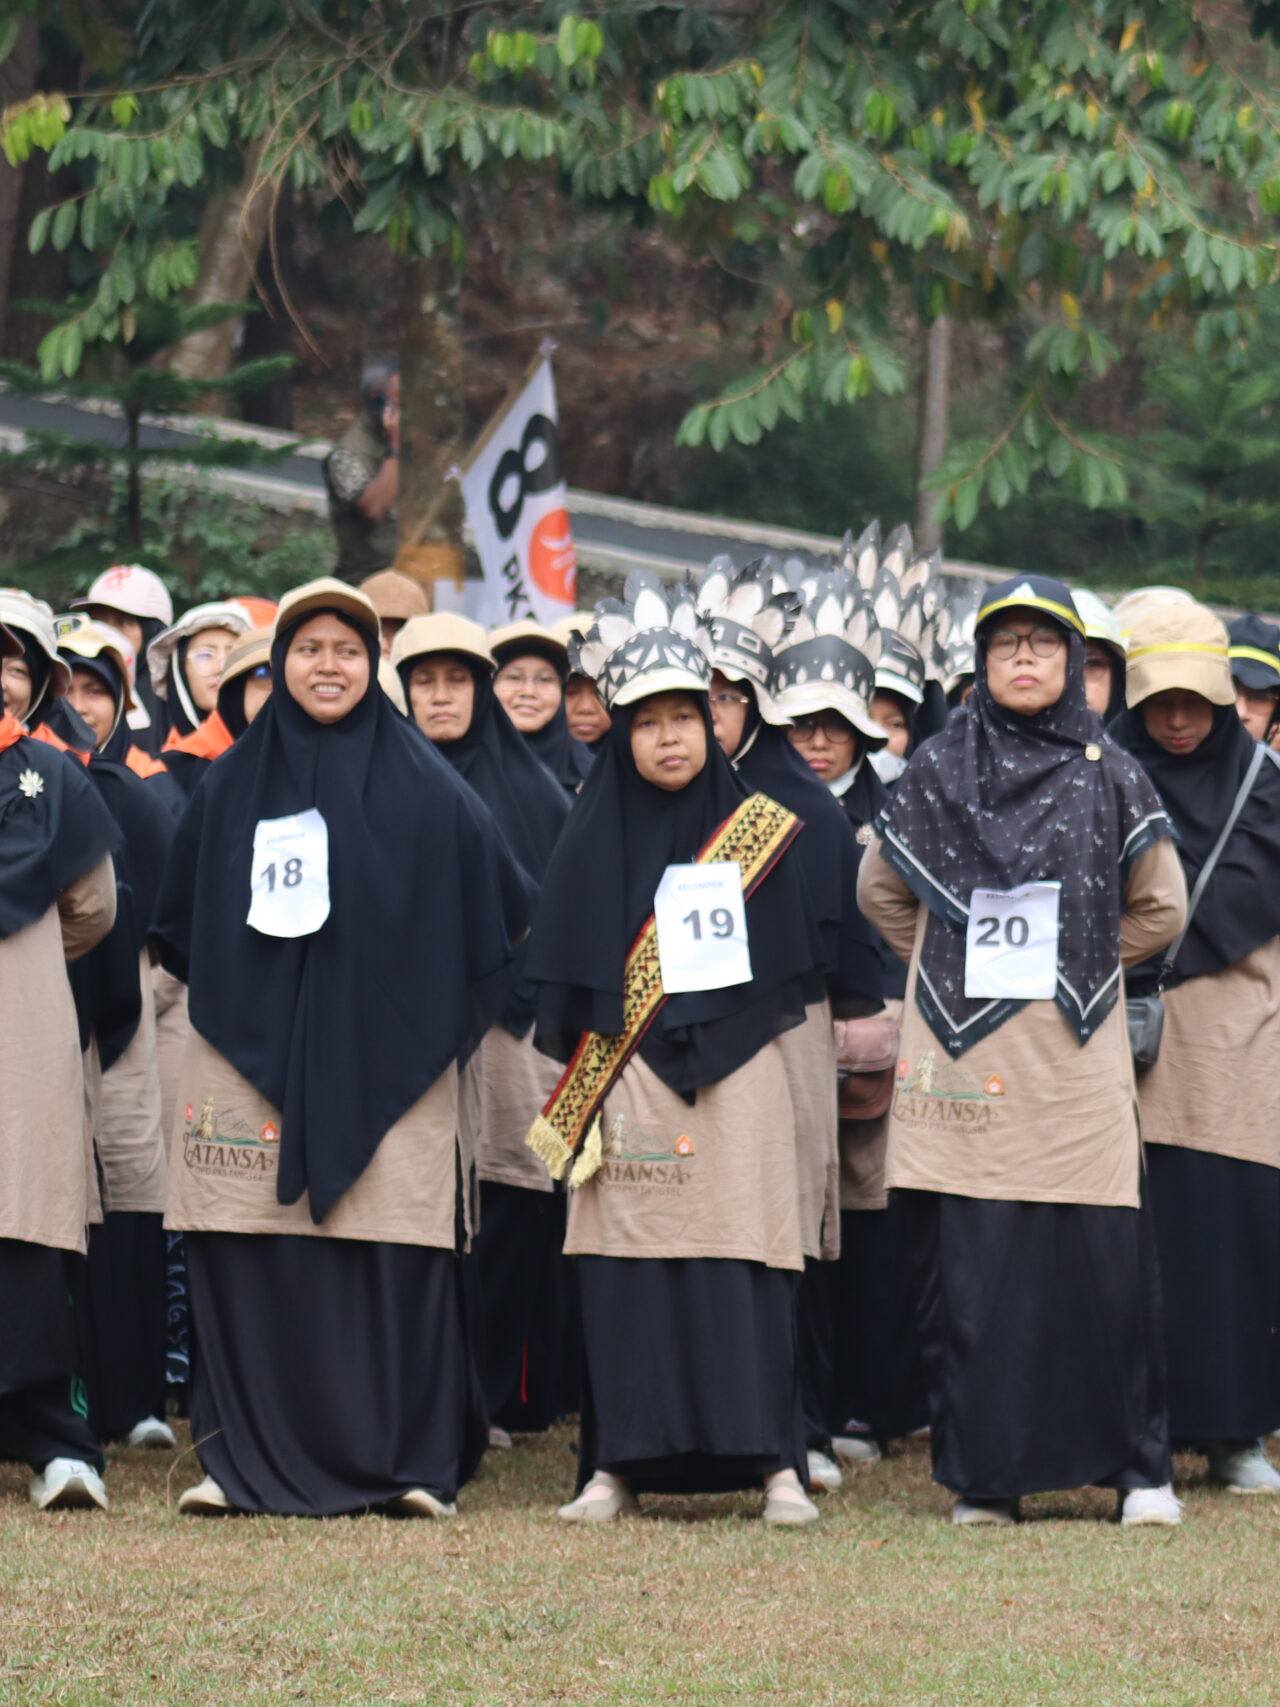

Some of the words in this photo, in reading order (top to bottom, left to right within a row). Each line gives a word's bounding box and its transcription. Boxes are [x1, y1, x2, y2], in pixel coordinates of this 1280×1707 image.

[489, 413, 562, 541] 8
[502, 553, 539, 622] PK
[260, 858, 303, 892] 18
[682, 908, 735, 941] 19
[975, 916, 1030, 949] 20
